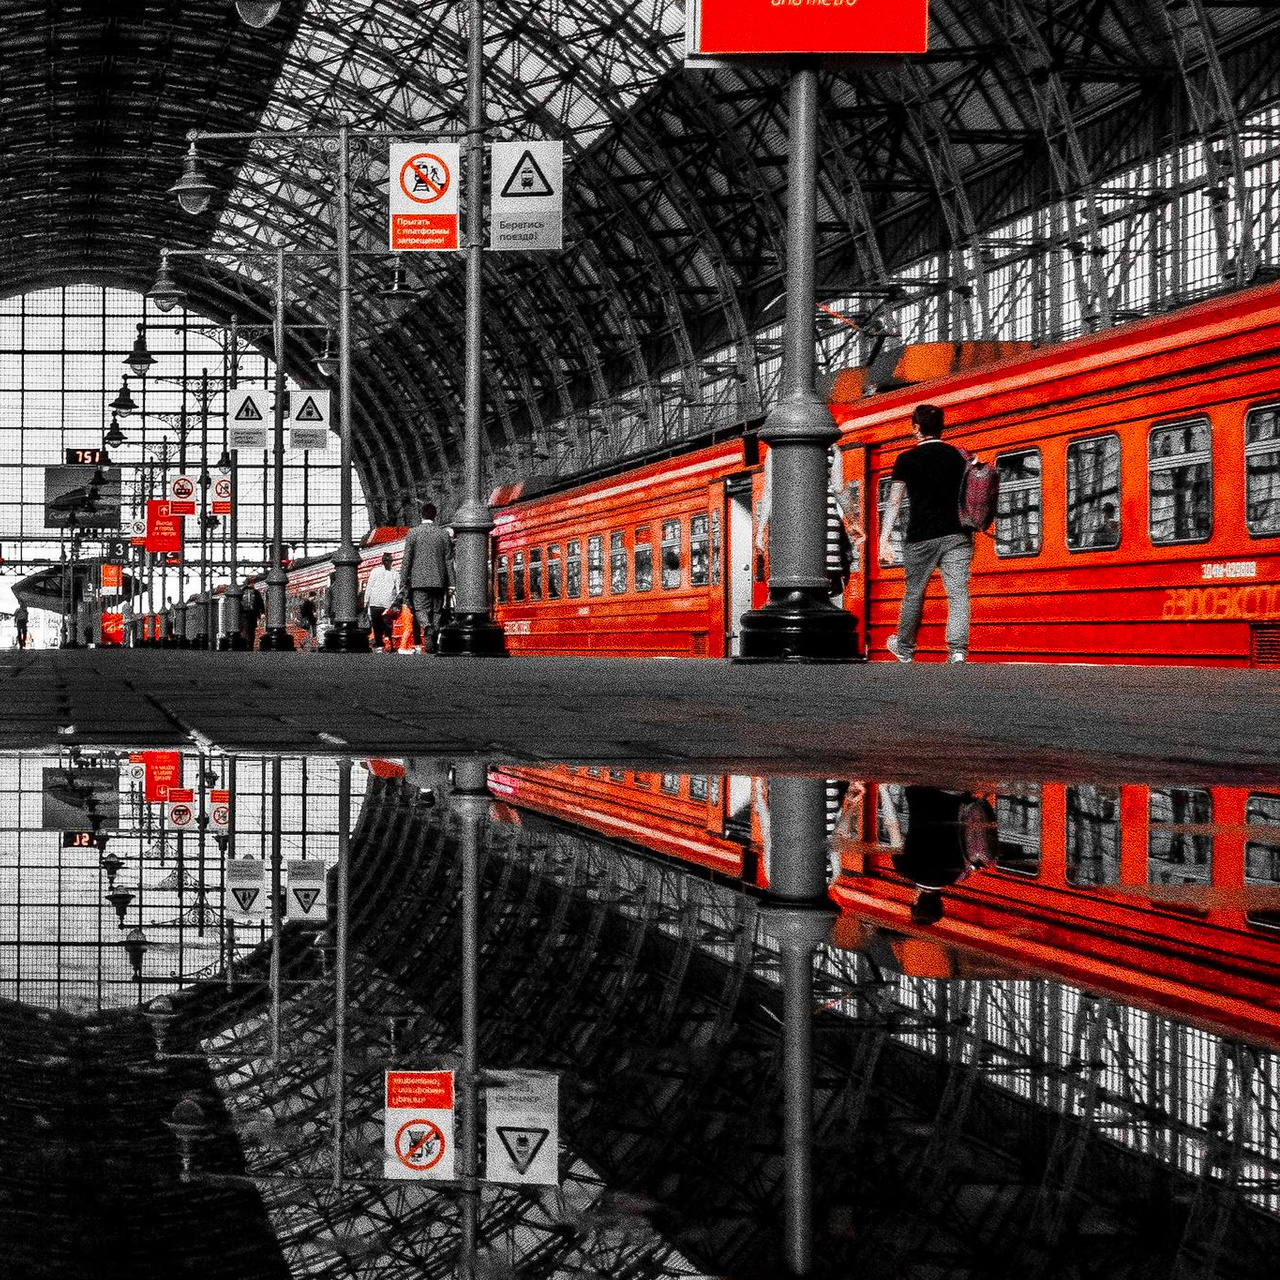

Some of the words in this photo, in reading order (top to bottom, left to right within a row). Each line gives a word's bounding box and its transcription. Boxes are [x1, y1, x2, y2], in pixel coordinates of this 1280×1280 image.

[397, 218, 431, 226] Прыгать
[500, 221, 545, 231] Берегись
[115, 543, 124, 556] 3
[87, 582, 93, 592] 3
